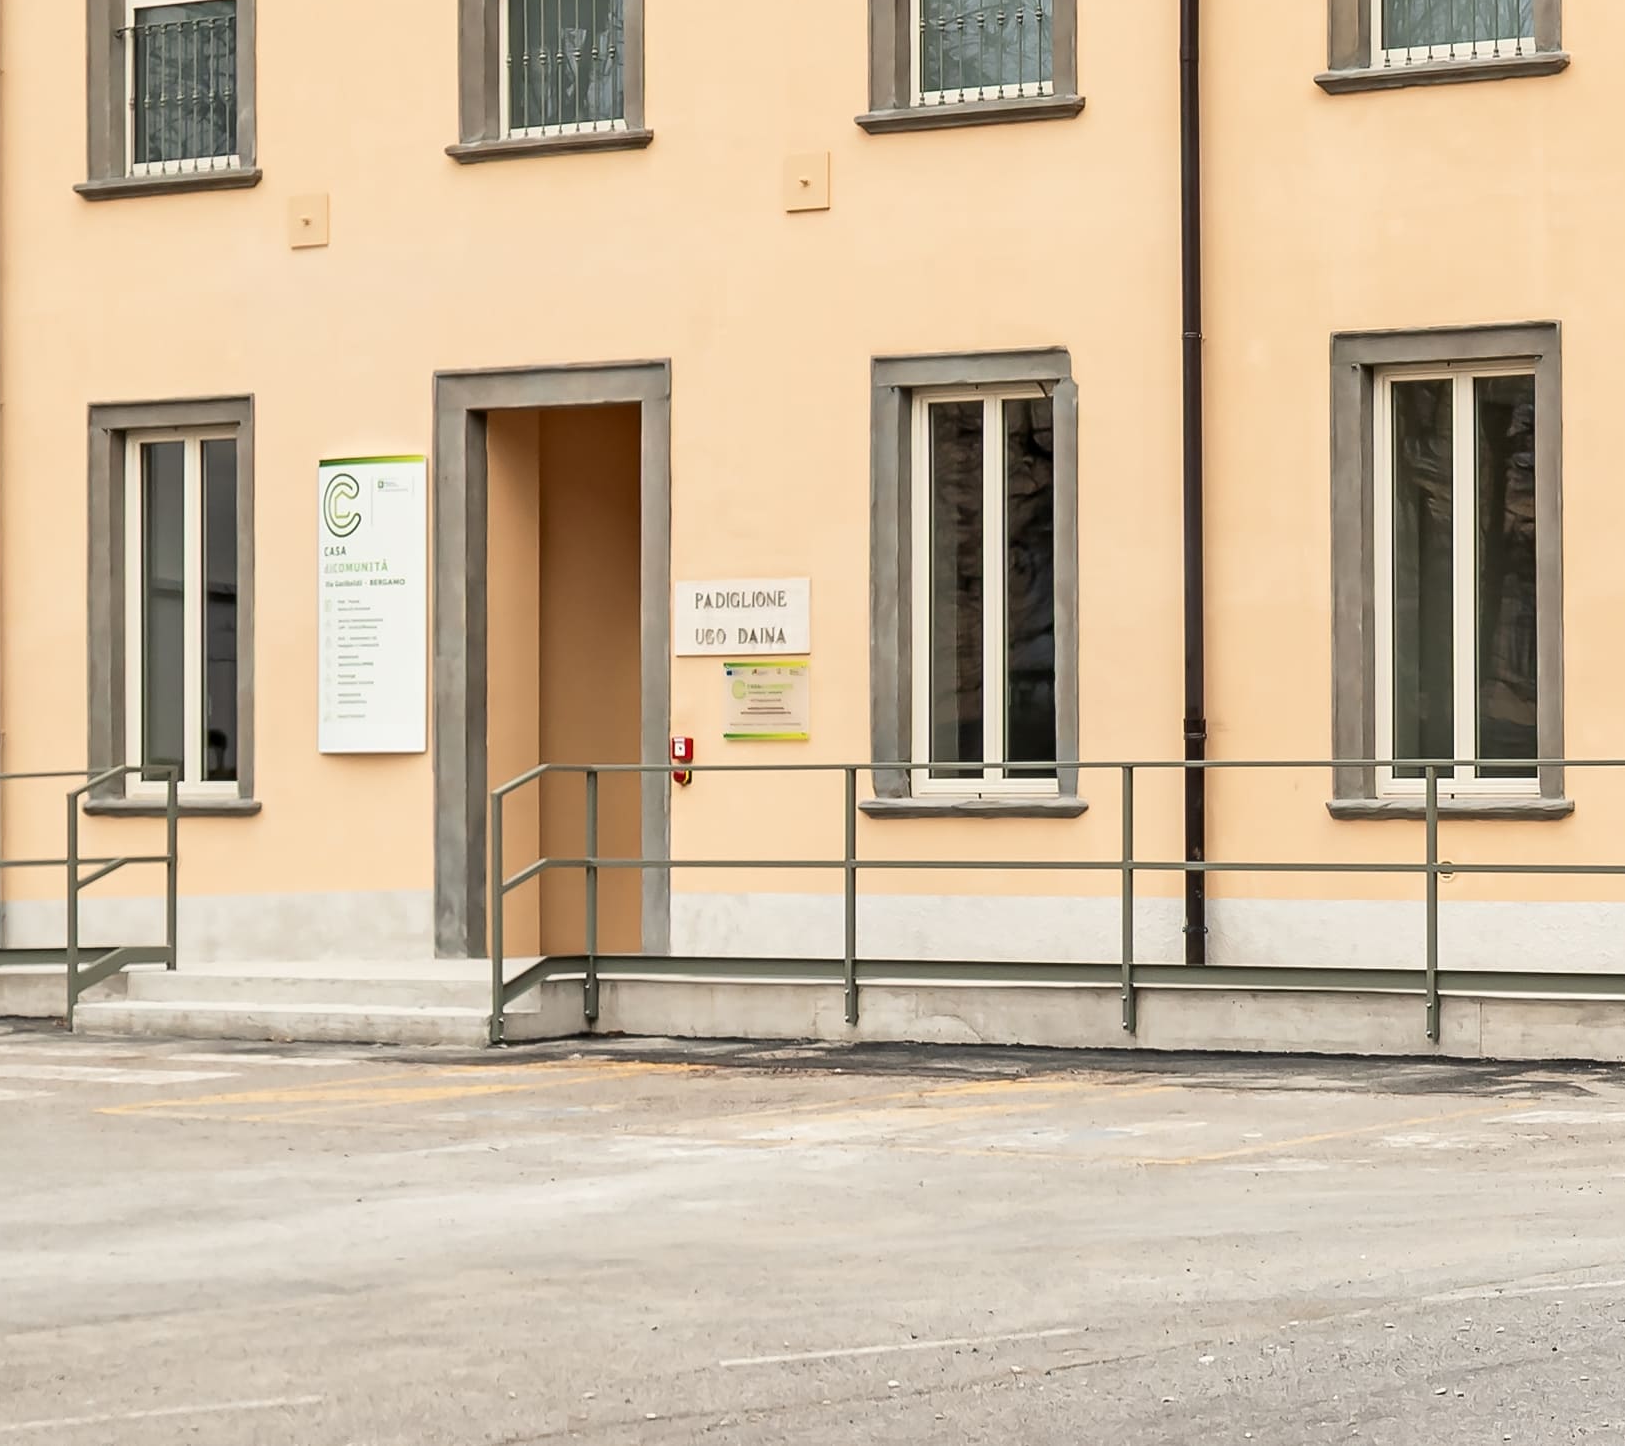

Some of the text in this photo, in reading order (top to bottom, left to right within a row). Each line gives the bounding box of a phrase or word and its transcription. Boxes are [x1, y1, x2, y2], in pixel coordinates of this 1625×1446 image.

[323, 546, 347, 557] CASA
[369, 578, 406, 586] BERGAMO
[695, 590, 788, 609] PADIGLIONE
[695, 627, 786, 645] UGO DAINA
